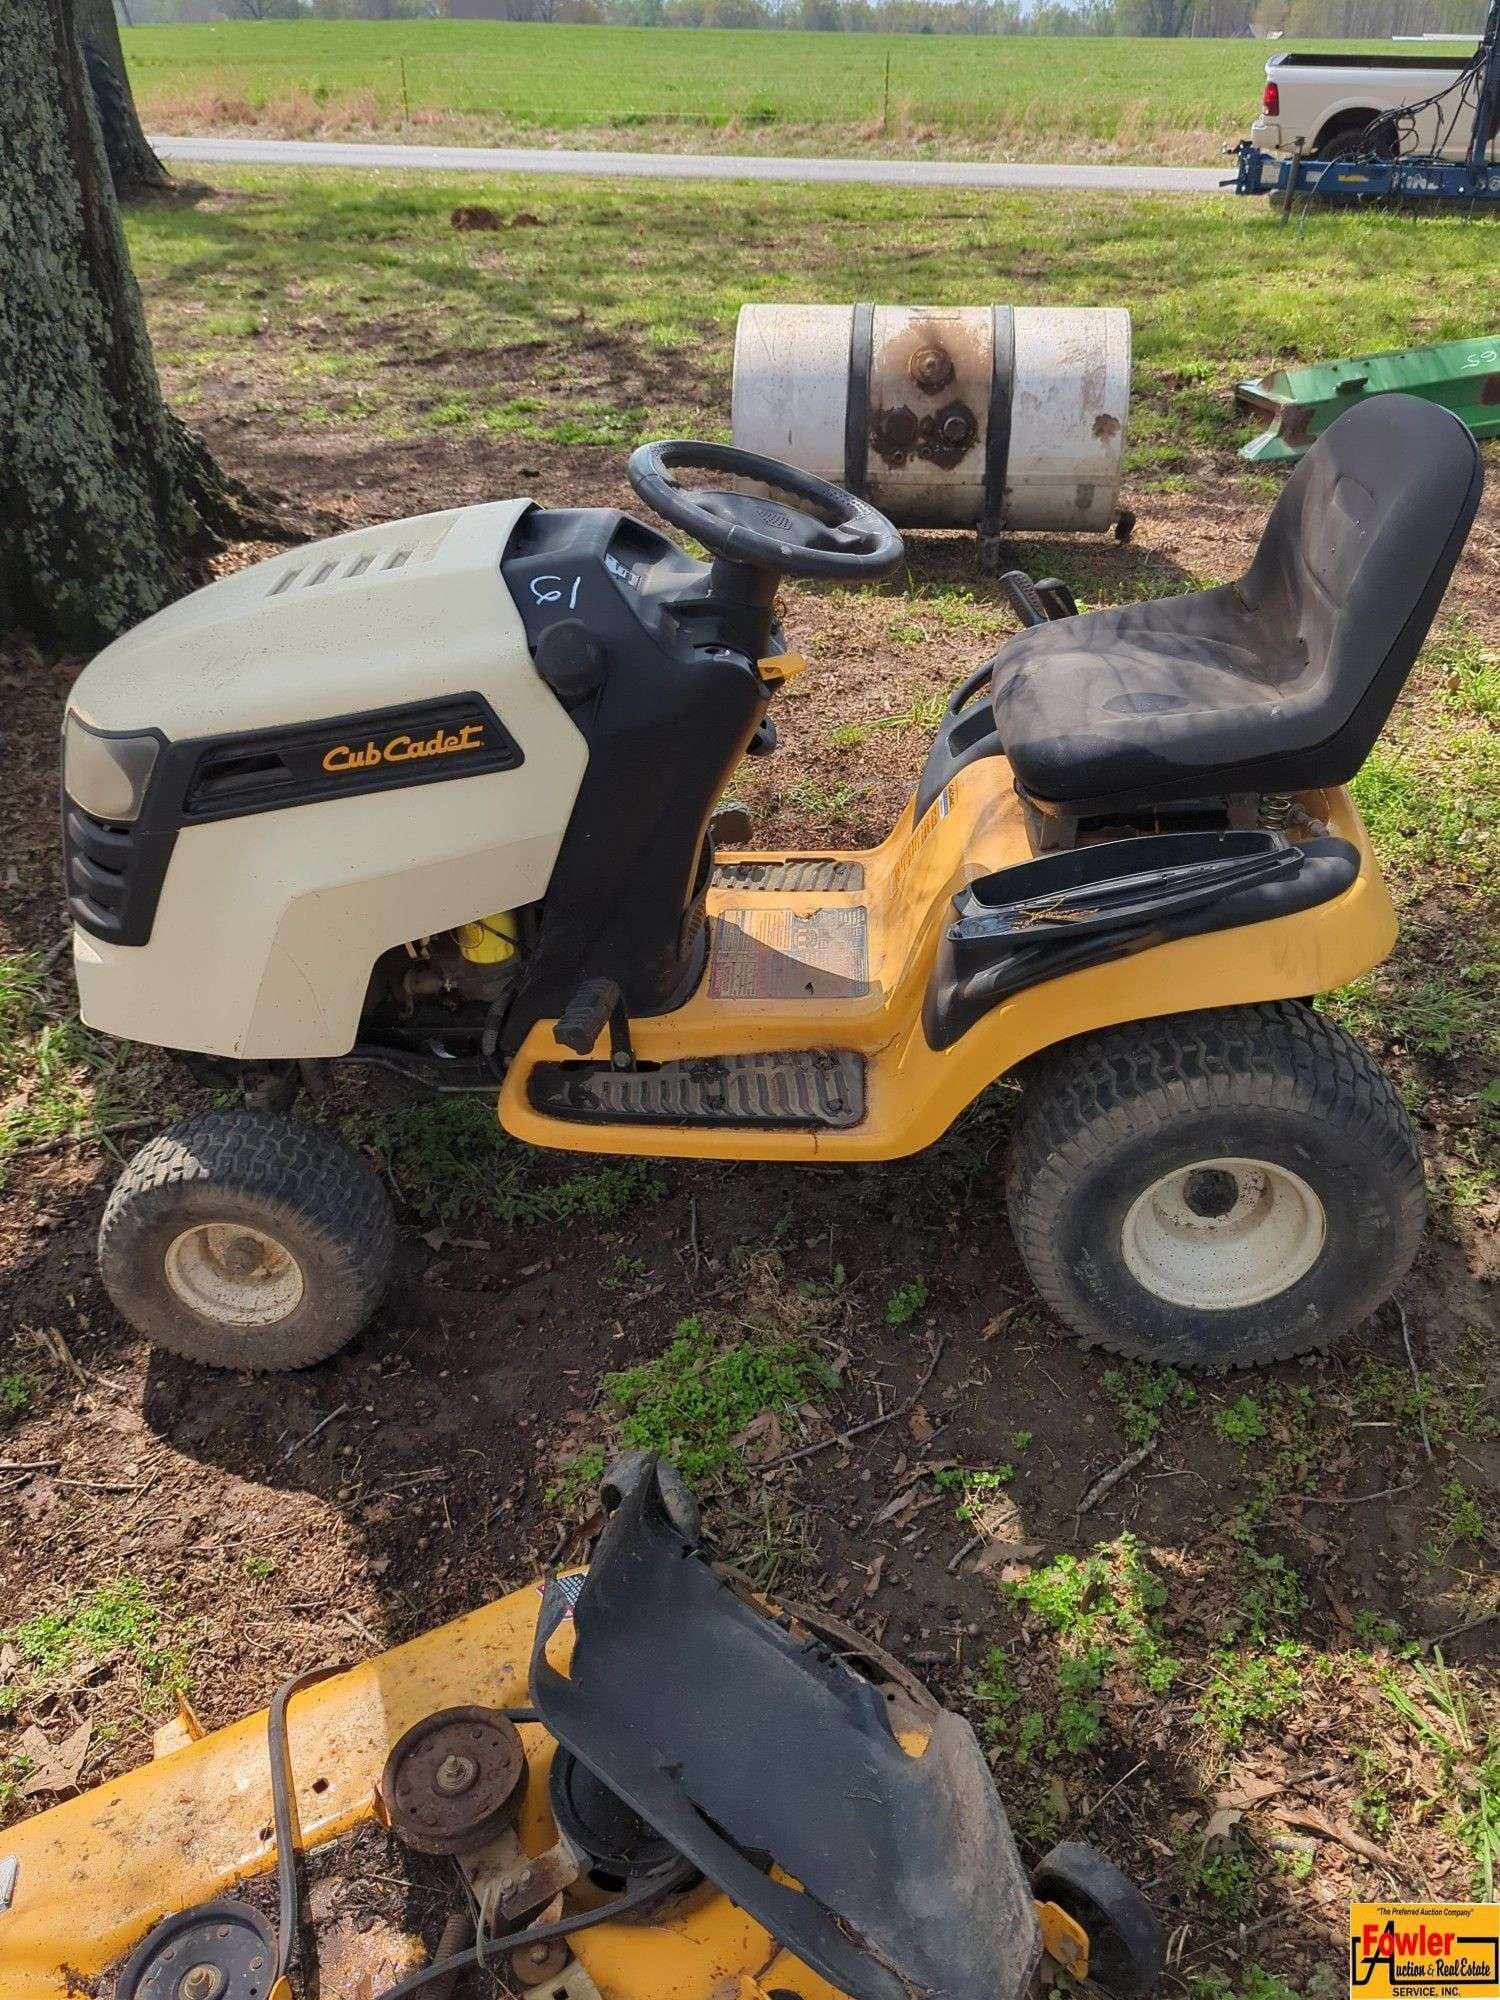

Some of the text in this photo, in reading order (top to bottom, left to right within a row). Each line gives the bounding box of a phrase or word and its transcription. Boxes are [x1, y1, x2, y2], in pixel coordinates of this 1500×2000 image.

[530, 575, 582, 609] 61
[322, 725, 483, 772] Cub Cadet
